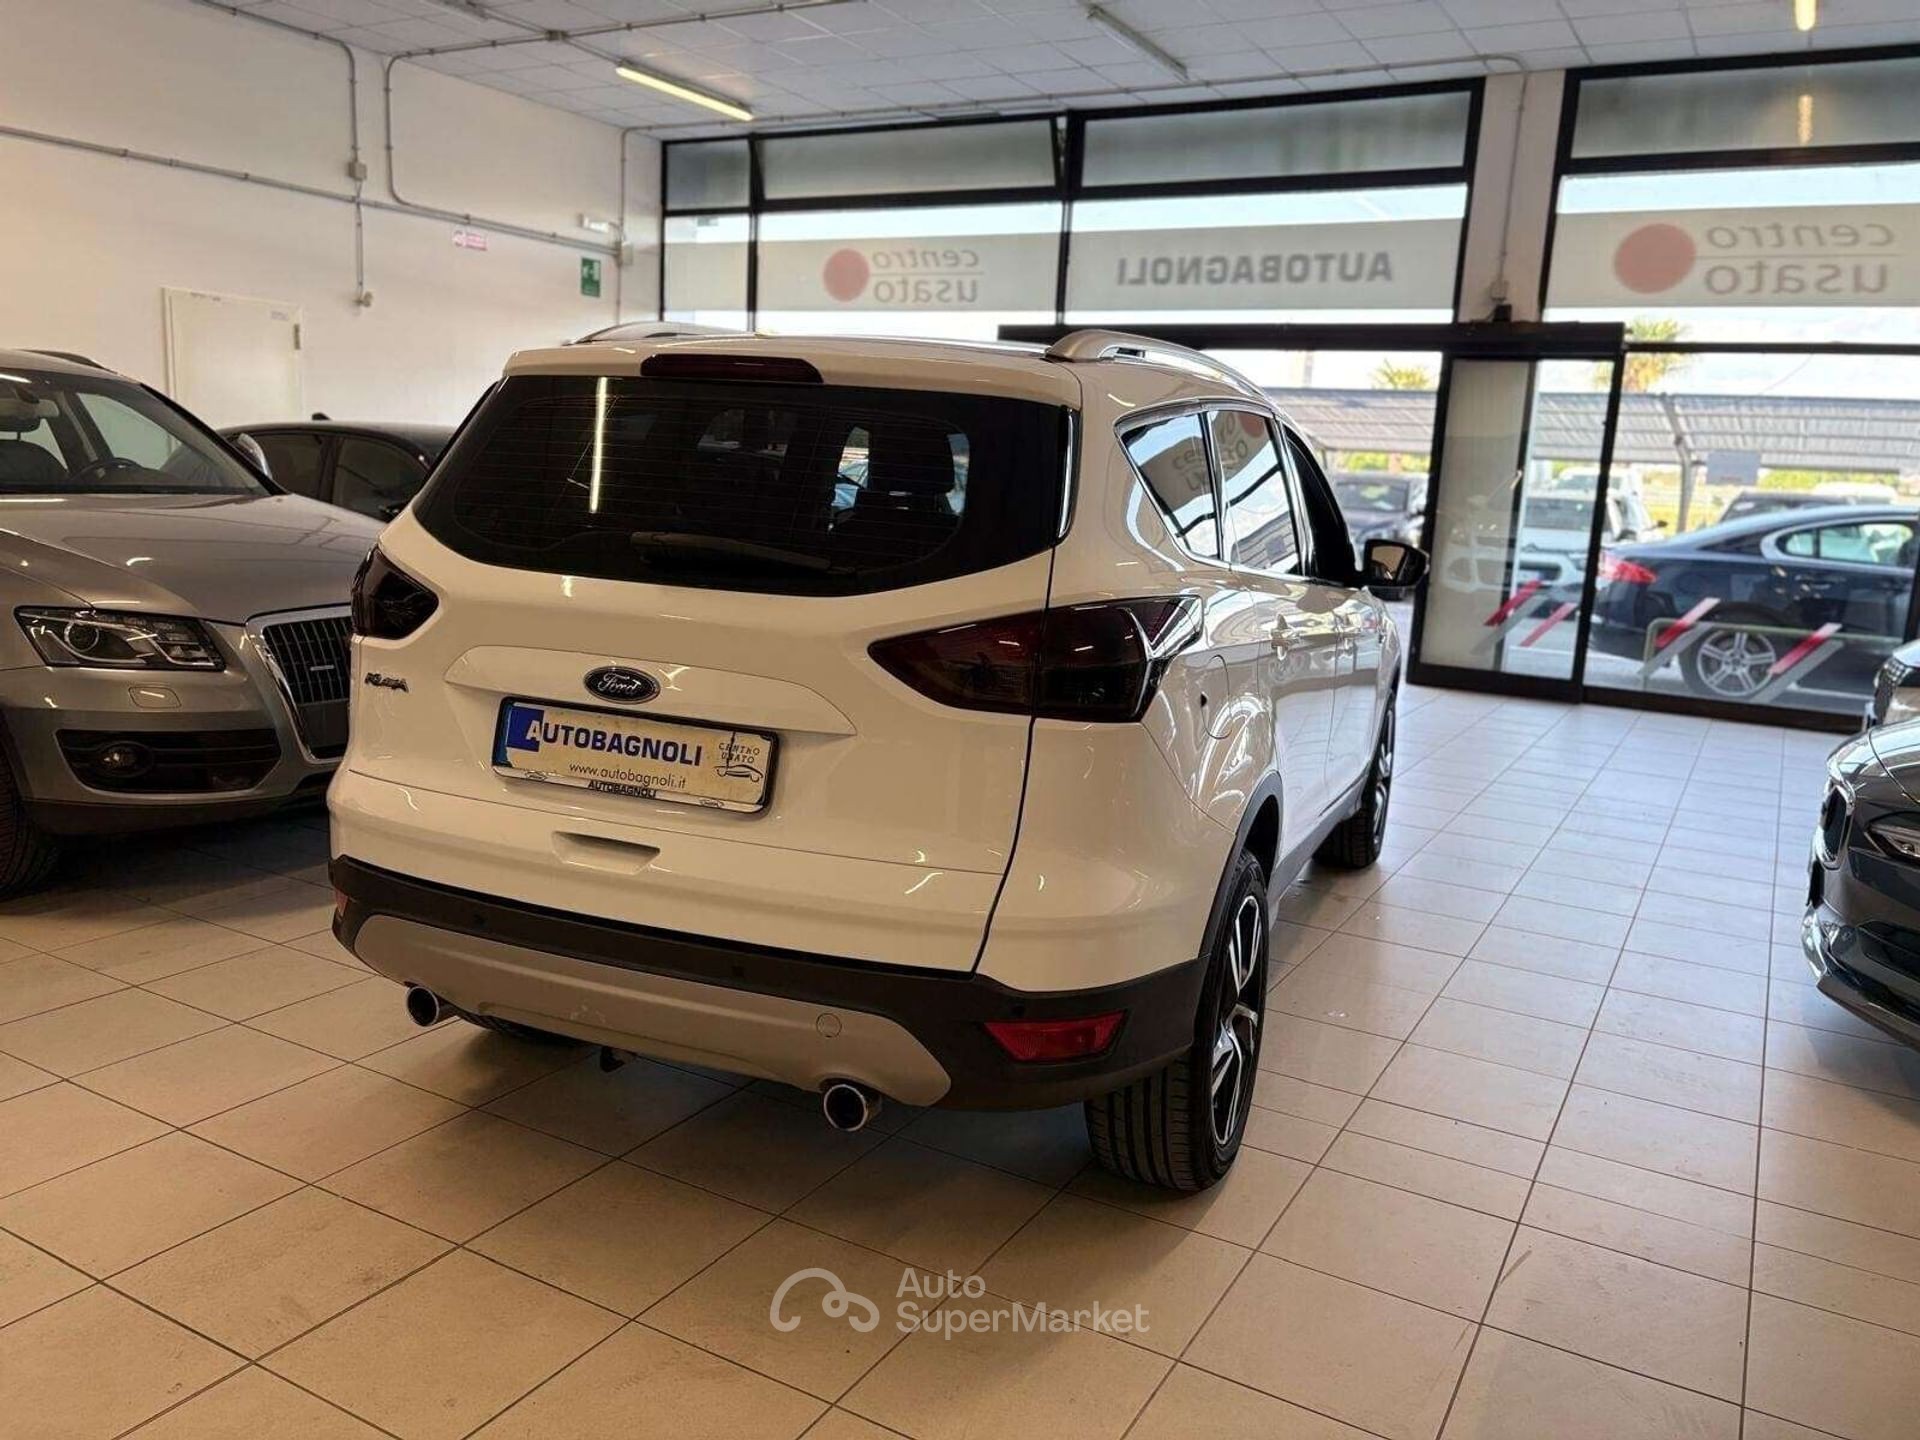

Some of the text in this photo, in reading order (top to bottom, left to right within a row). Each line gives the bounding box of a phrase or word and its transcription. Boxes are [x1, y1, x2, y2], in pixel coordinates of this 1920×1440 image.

[597, 672, 642, 695] Ford
[525, 719, 703, 767] AUTOBAGNOLI
[568, 762, 687, 789] www.autobagnoli.it
[587, 779, 658, 799] AUTOBAGNOLI
